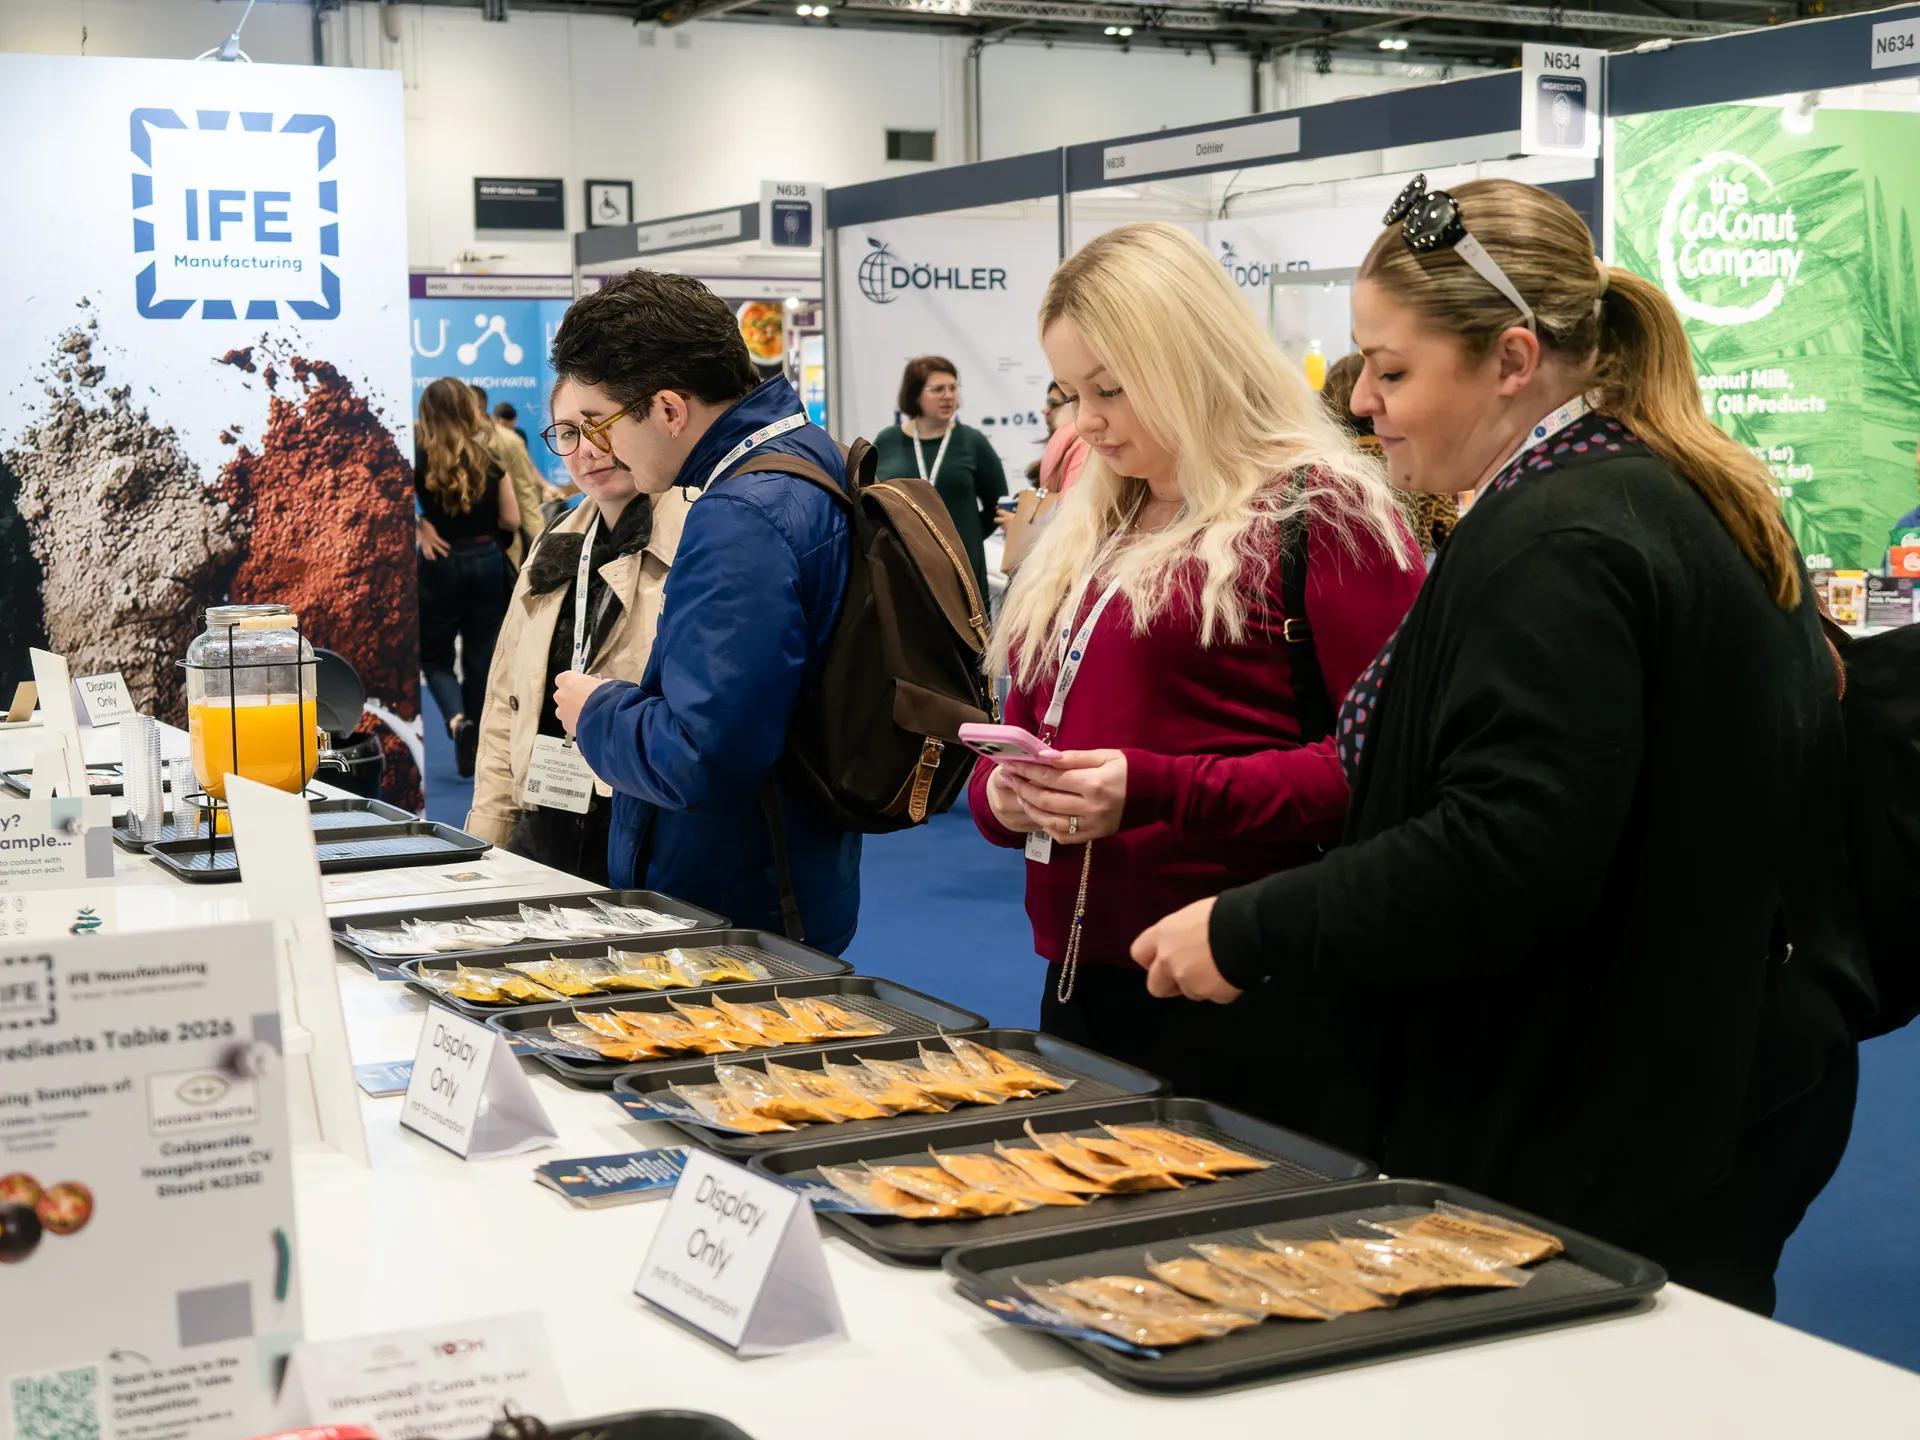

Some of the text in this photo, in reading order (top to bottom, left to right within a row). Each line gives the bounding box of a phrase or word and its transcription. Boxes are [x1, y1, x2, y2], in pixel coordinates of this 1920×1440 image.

[1877, 33, 1914, 54] N634
[1544, 52, 1580, 70] N634
[1541, 82, 1582, 92] INGREDIENTS
[1105, 142, 1224, 169] N638 Döhler
[776, 184, 806, 197] N638
[1708, 173, 1748, 205] the
[185, 189, 292, 242] IFE
[1680, 202, 1798, 241] CoConut
[174, 254, 303, 272] Manufacturing
[1680, 241, 1804, 287] Company
[891, 263, 1007, 290] DÖHLER
[499, 376, 537, 389] WATER
[1717, 394, 1744, 414] Oil
[1746, 393, 1826, 413] Products
[86, 680, 117, 693] Display
[97, 696, 117, 708] Only
[9, 858, 42, 866] contact
[44, 865, 64, 874] each
[96, 961, 208, 981] Manufacturing
[103, 1025, 170, 1049] Table
[176, 1018, 235, 1042] 2026
[432, 1023, 480, 1070] Display
[35, 1081, 109, 1102] Samples
[430, 1067, 460, 1106] Only
[695, 1173, 767, 1238] Display
[687, 1228, 733, 1280] Only
